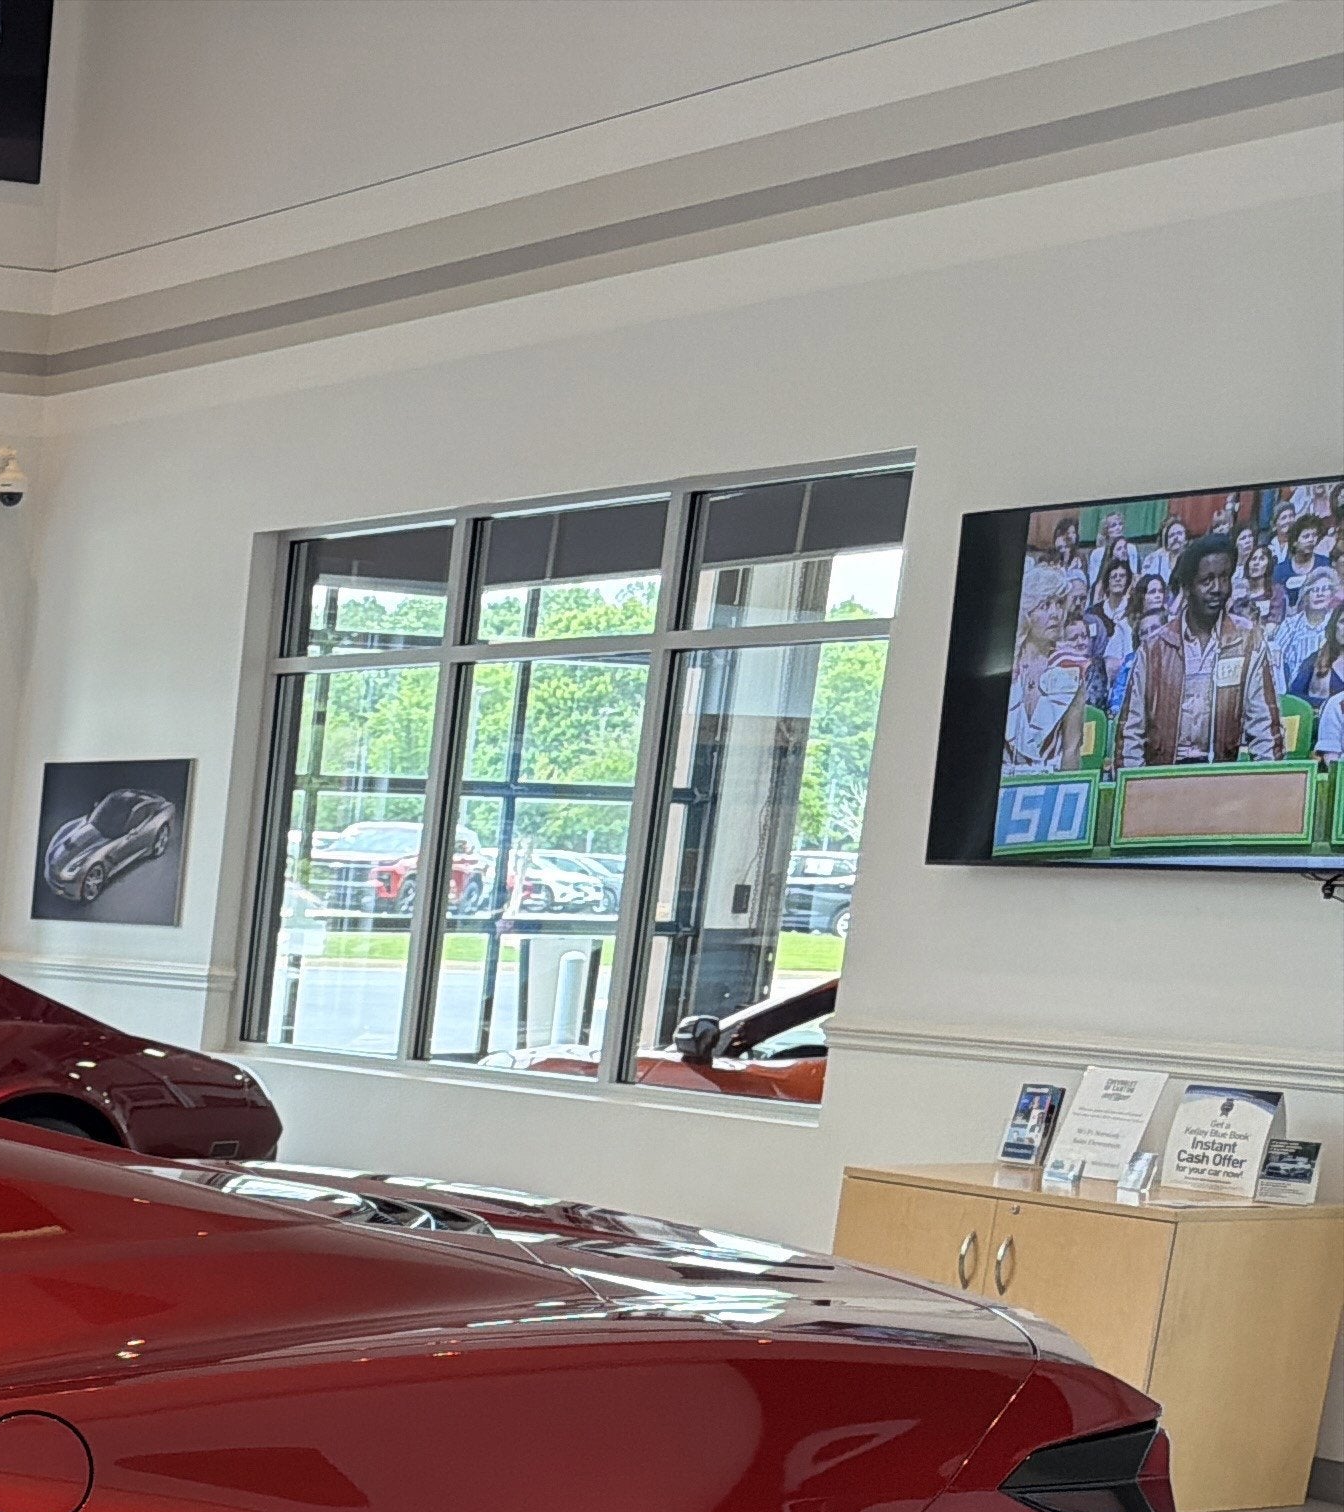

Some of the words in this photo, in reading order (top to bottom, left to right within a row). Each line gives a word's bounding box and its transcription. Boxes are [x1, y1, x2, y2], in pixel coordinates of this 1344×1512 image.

[1210, 1119, 1224, 1129] Get
[1184, 1126, 1208, 1137] Kelley
[1210, 1128, 1228, 1138] Blue
[1229, 1131, 1250, 1141] Book
[1191, 1136, 1238, 1154] Instant
[1177, 1150, 1210, 1165] Cash
[1212, 1153, 1247, 1168] Offer
[1175, 1164, 1187, 1173] for
[1188, 1166, 1206, 1176] your
[1207, 1168, 1221, 1176] car
